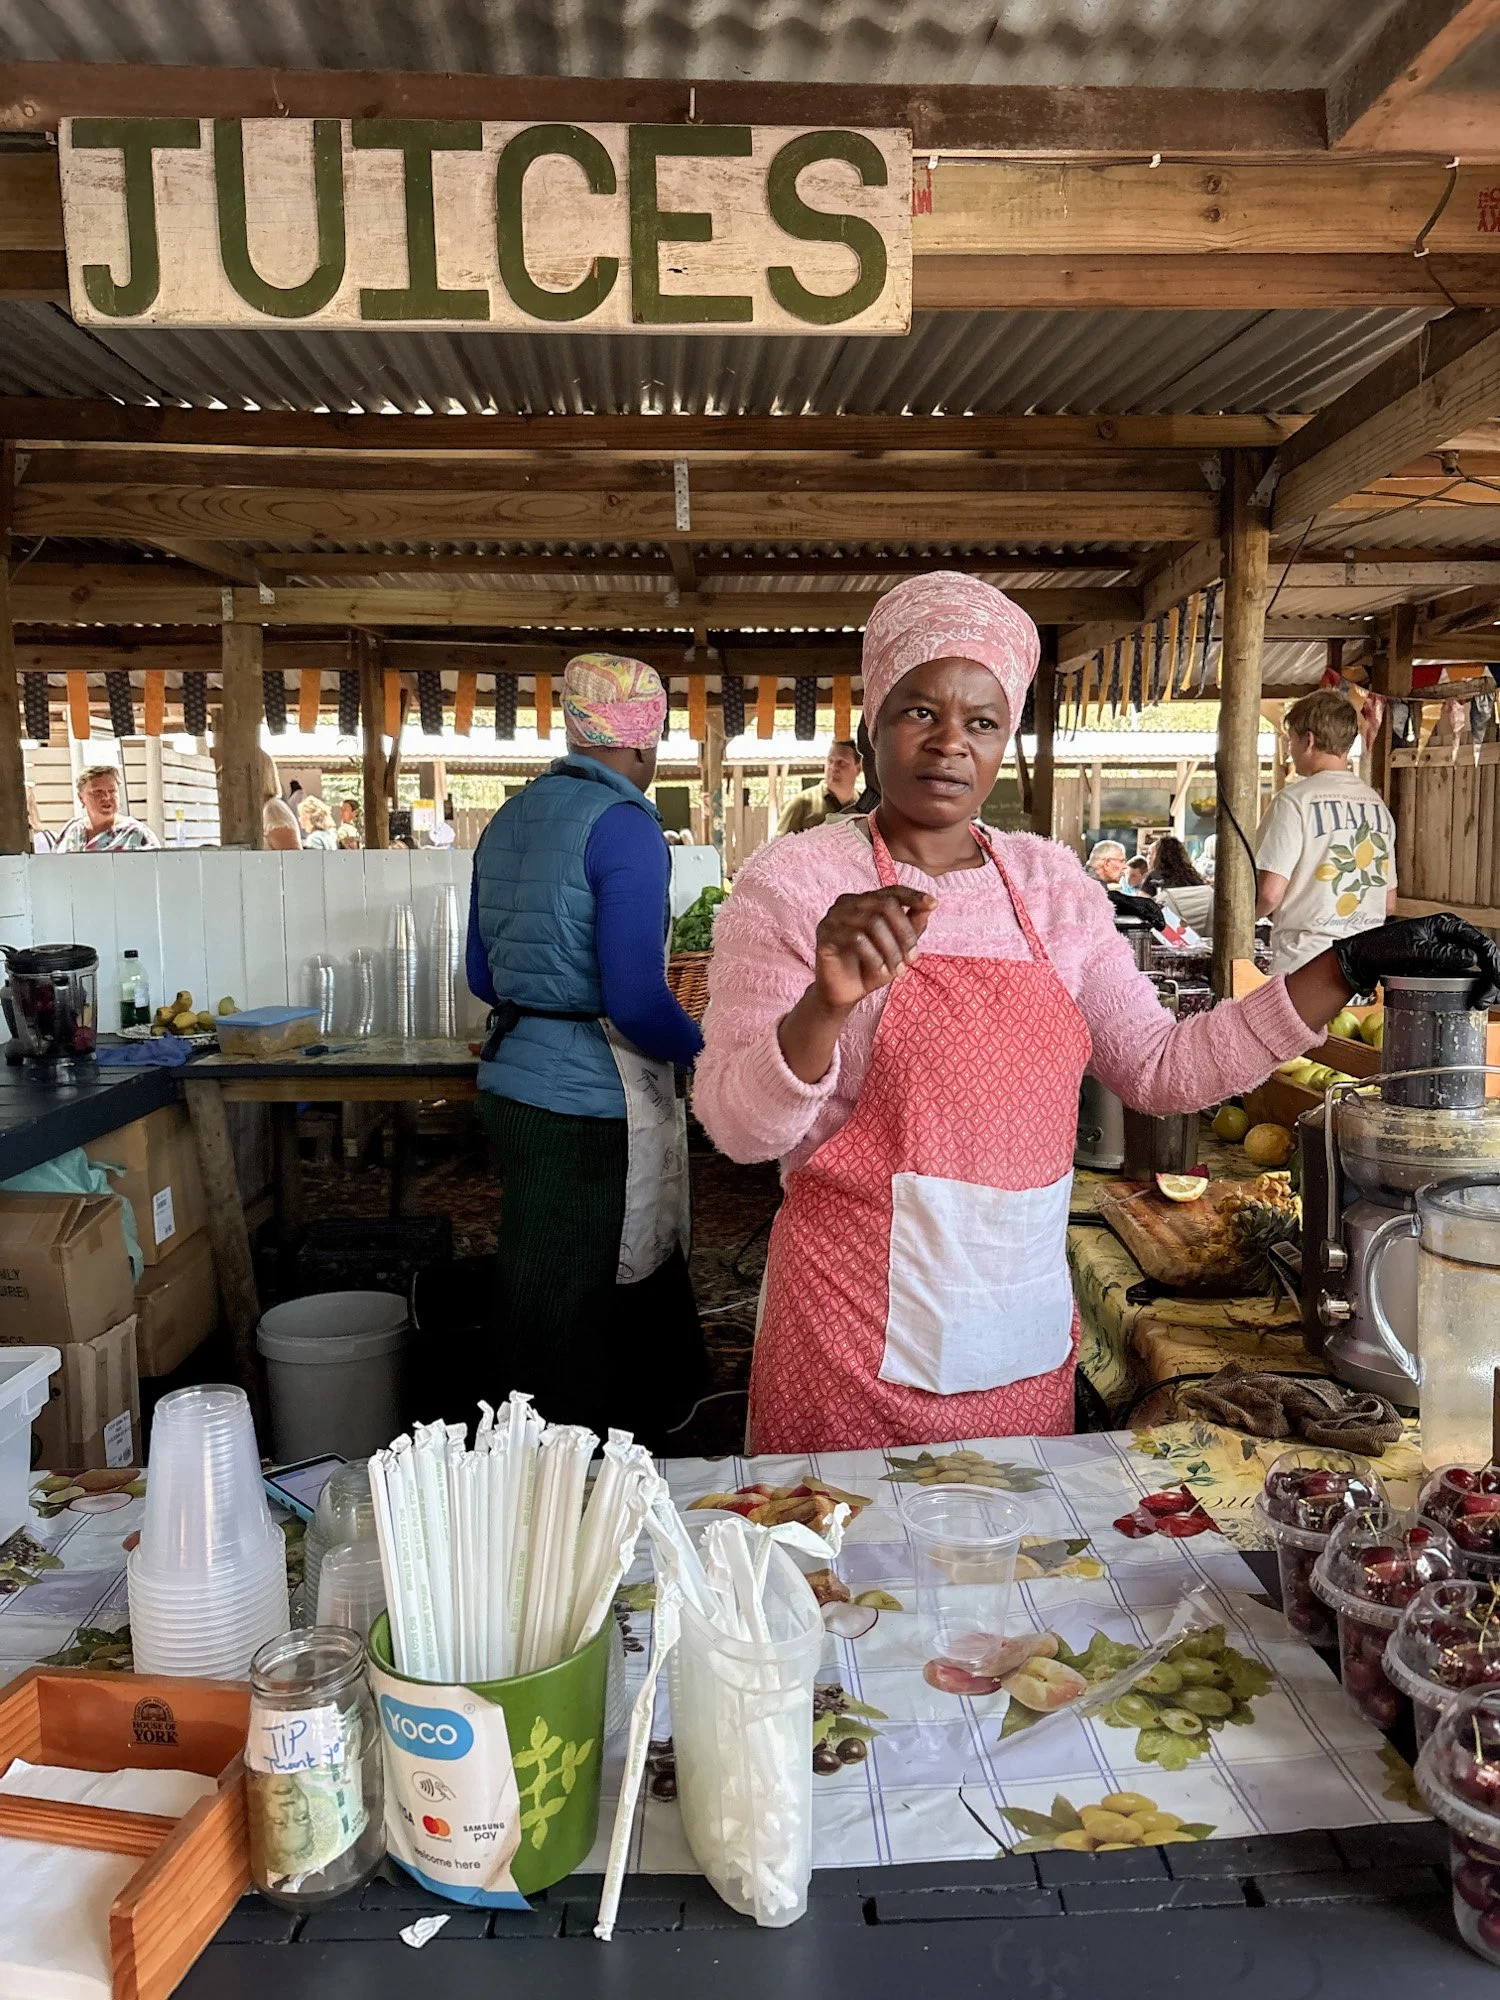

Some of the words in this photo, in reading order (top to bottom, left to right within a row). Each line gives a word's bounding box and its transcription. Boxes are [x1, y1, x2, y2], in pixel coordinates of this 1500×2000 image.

[72, 118, 889, 325] JUICES
[132, 1720, 163, 1730] HOUSE
[132, 1729, 178, 1744] YORK
[262, 1720, 307, 1763] TIP
[463, 1822, 505, 1833] SAMSUNG
[473, 1830, 497, 1842] pay
[413, 1845, 452, 1868] welcome
[455, 1859, 481, 1869] here
